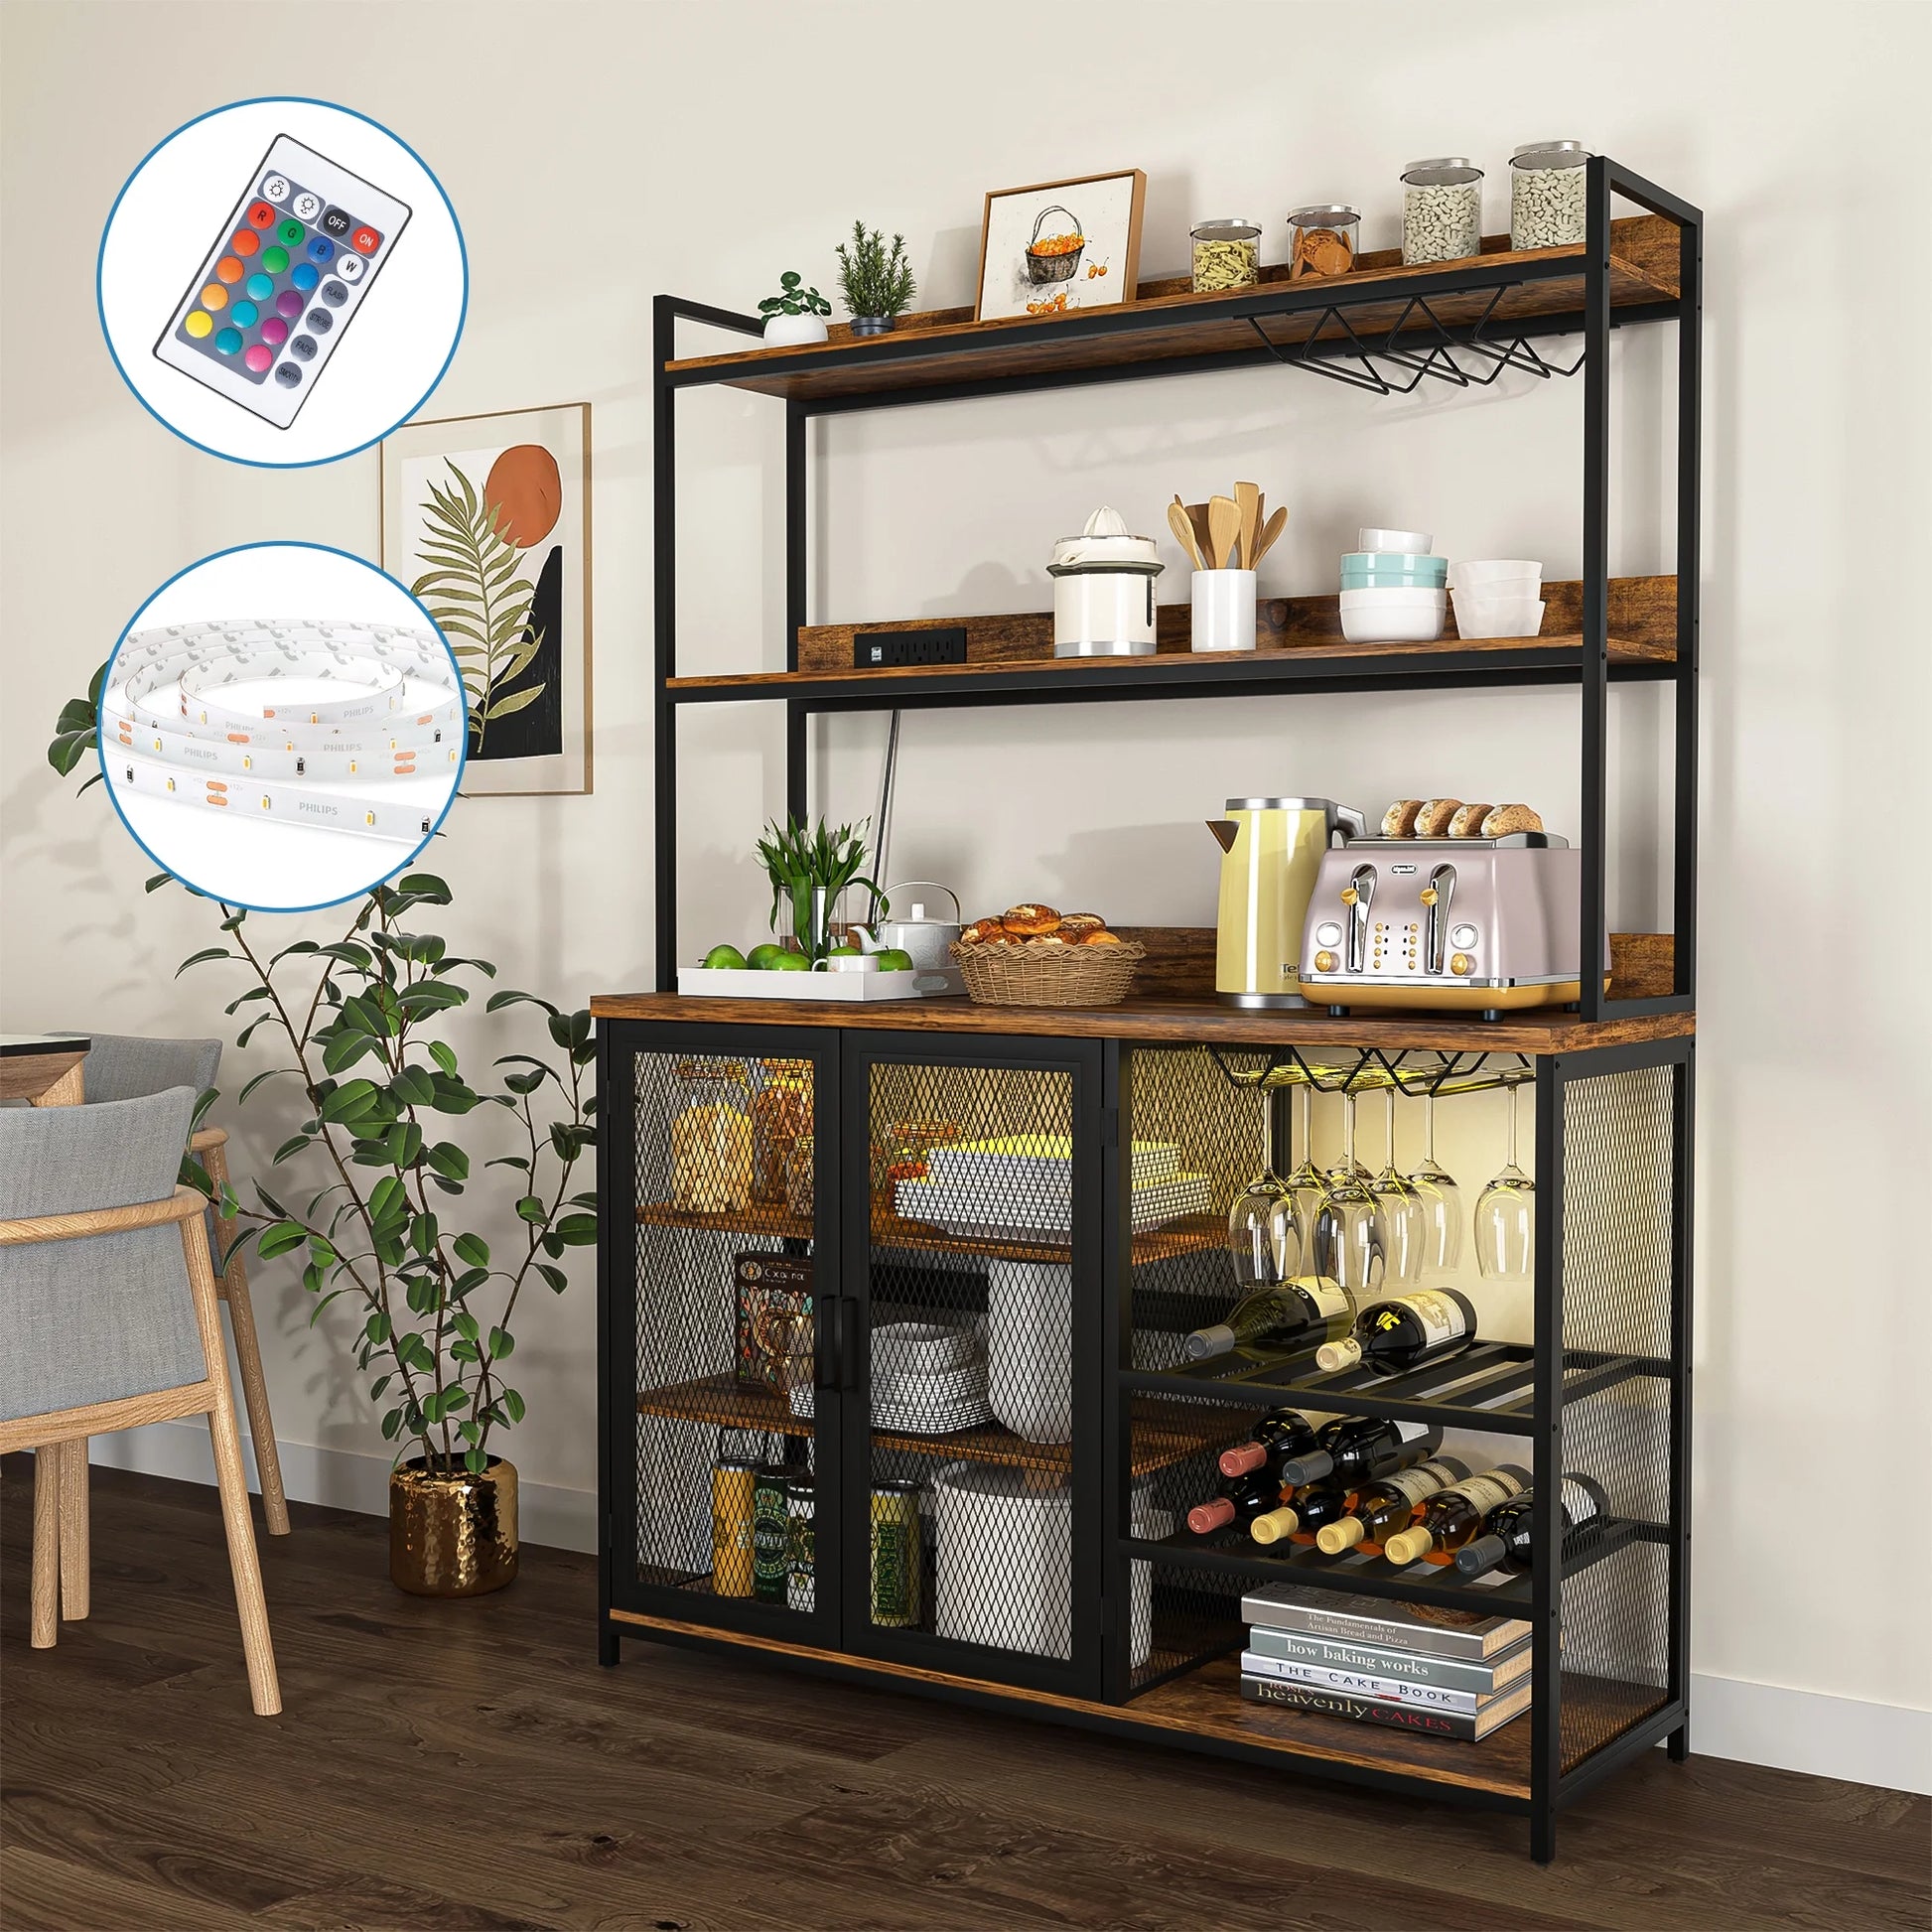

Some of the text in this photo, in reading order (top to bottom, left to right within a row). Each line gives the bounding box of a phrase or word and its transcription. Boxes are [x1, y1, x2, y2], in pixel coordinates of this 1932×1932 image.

[257, 209, 267, 221] R
[328, 215, 347, 230] OFF
[287, 227, 297, 238] G
[358, 233, 374, 247] ON
[316, 244, 327, 256] B
[345, 260, 357, 273] W
[326, 286, 345, 302] FLASH
[309, 313, 331, 330] STROBE
[295, 340, 314, 356] FADE
[343, 705, 374, 719] PHILIPS
[184, 747, 218, 761] PHILIPS
[323, 743, 363, 753] PHILIPS
[299, 801, 339, 816] PHILIPS
[1308, 1613, 1324, 1622] The
[1326, 1616, 1385, 1632] Fundamentals
[1308, 1622, 1409, 1645] Artisan Bread and Pizza
[1287, 1639, 1430, 1677] how baking works
[1276, 1663, 1452, 1703] THE CAKE BOOK
[1256, 1683, 1452, 1731] heavenly CAKES
